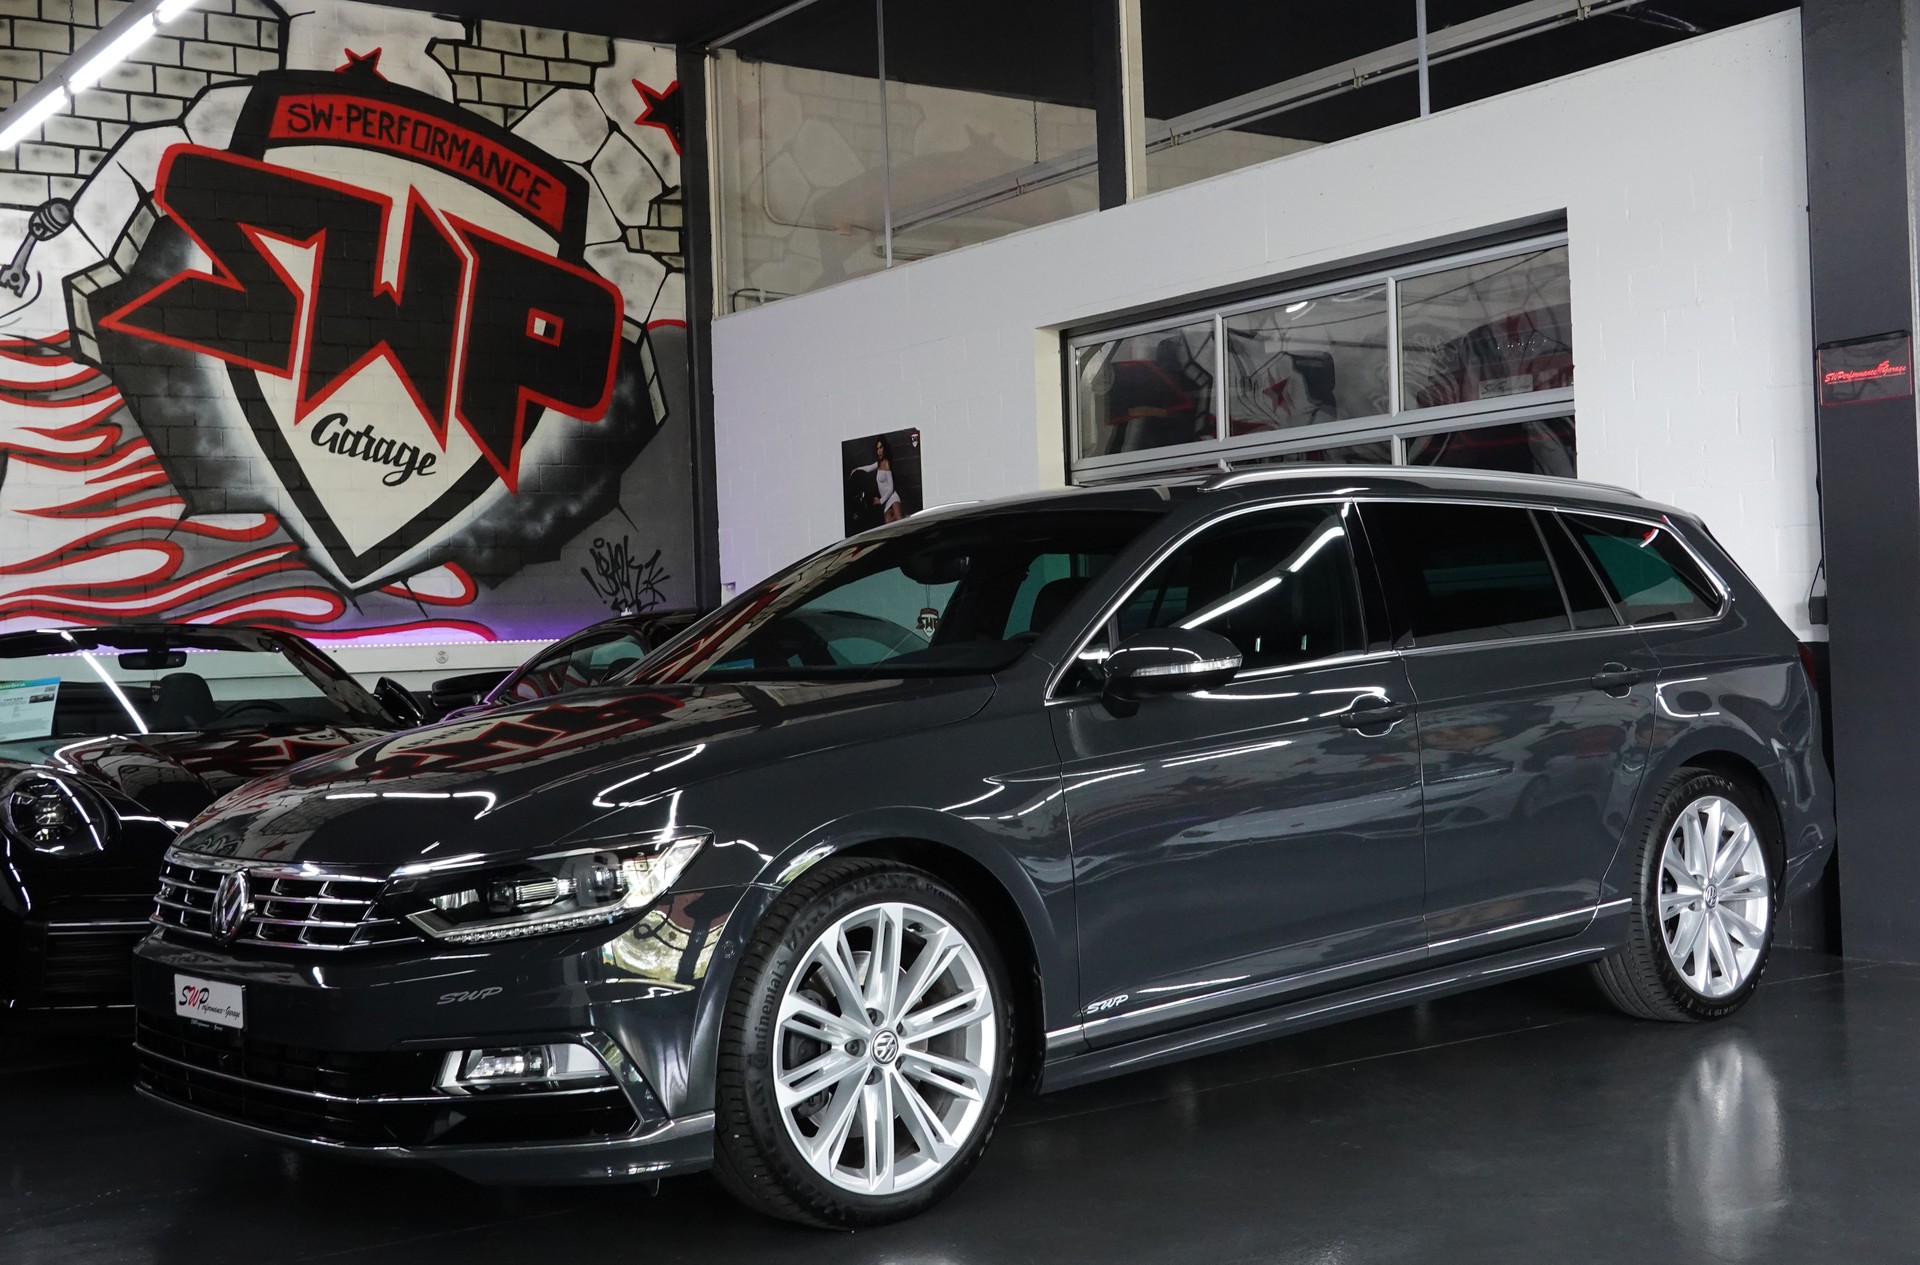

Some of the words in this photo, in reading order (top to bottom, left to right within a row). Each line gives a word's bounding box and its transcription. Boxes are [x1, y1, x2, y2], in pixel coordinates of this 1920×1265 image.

[287, 102, 553, 211] SW-PERFORMANCE
[98, 142, 624, 494] SWP
[310, 412, 437, 487] Garage
[436, 986, 503, 1005] SWP
[1086, 994, 1129, 1015] SWP
